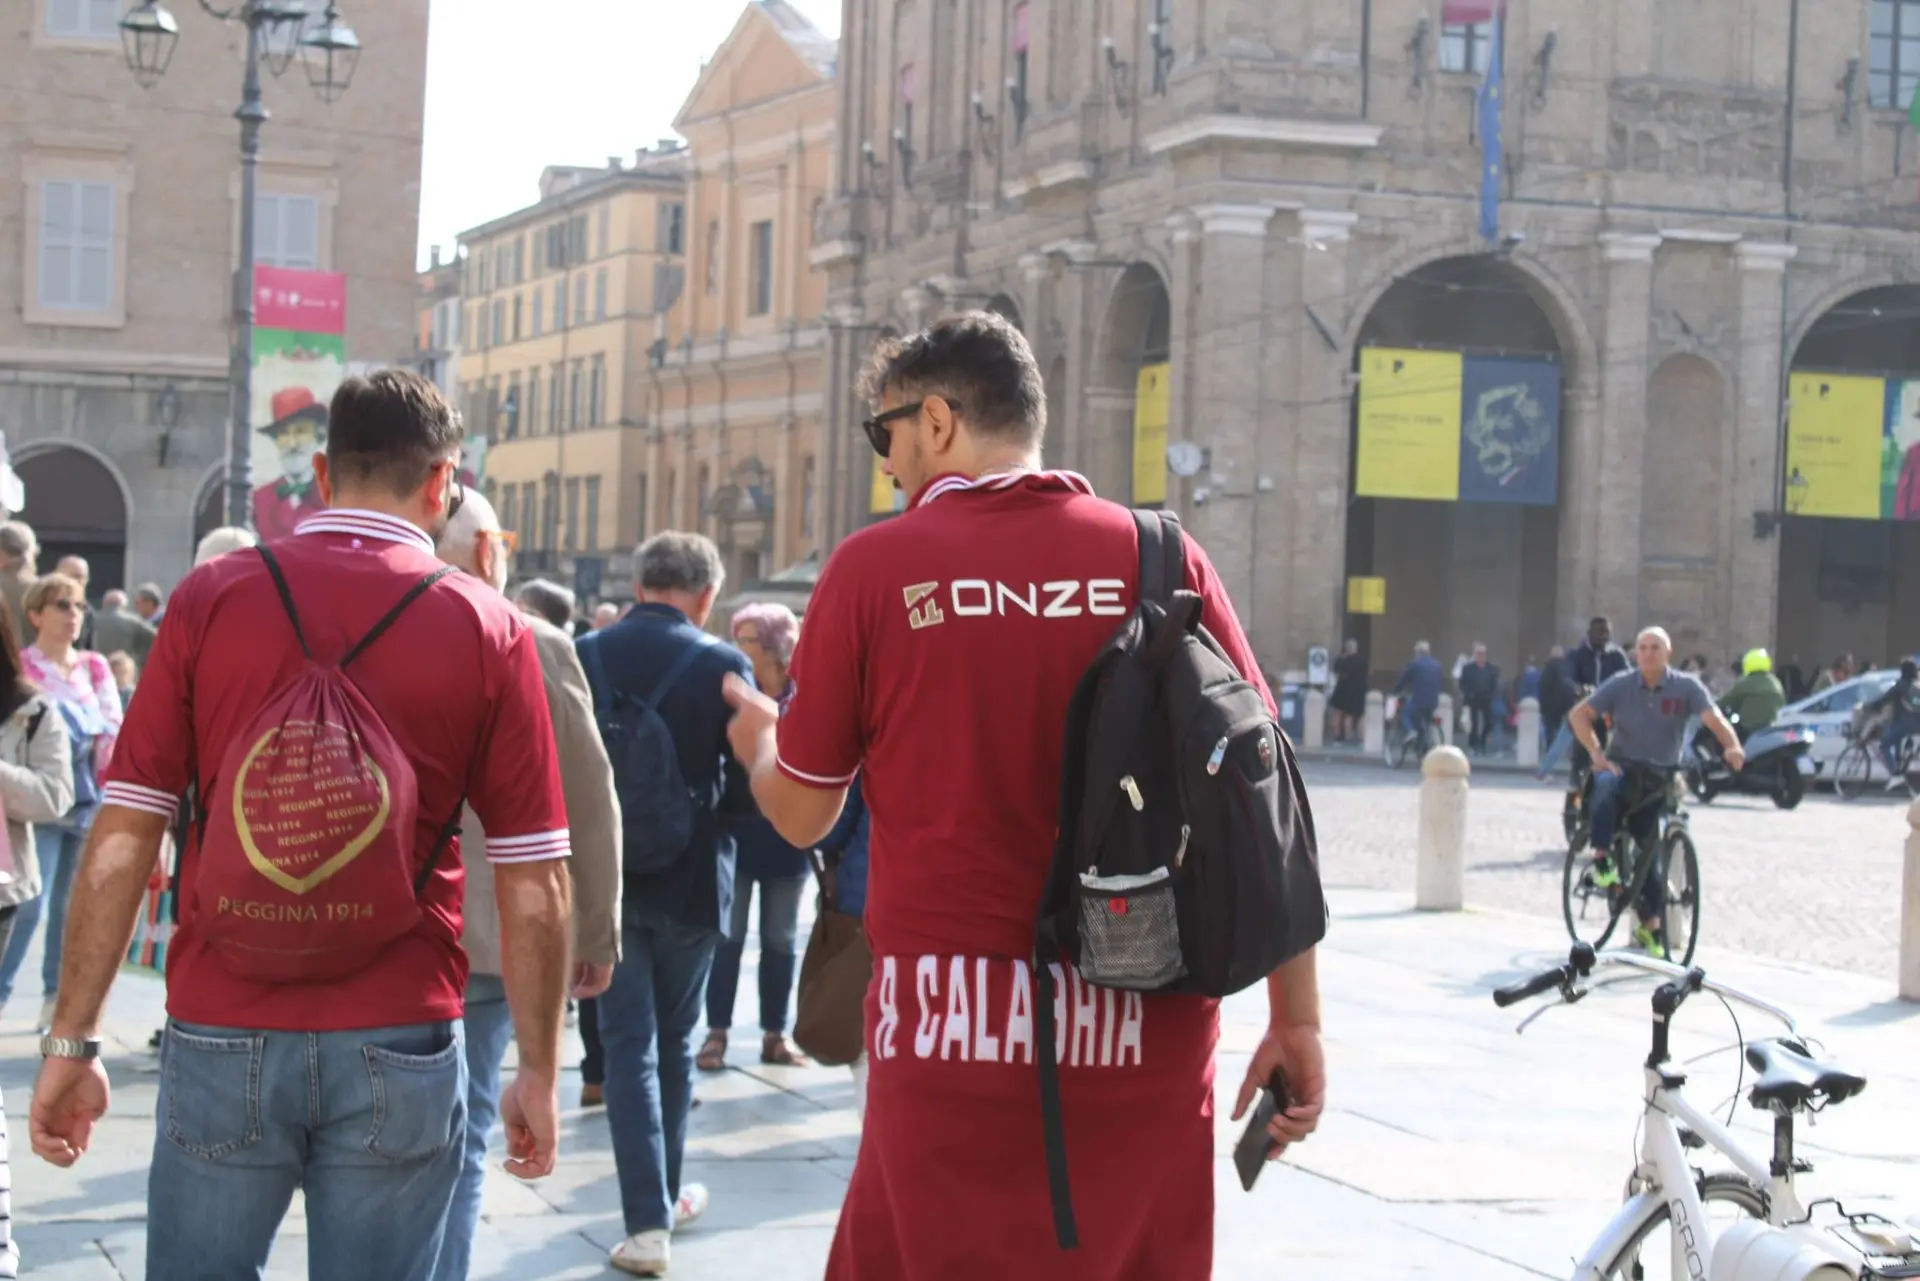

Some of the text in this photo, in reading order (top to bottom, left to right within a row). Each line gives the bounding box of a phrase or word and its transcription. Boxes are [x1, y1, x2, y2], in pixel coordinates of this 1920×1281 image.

[950, 579, 1127, 618] ONZE
[217, 896, 374, 922] REGGINA 1914
[1671, 1198, 1706, 1281] GRO
